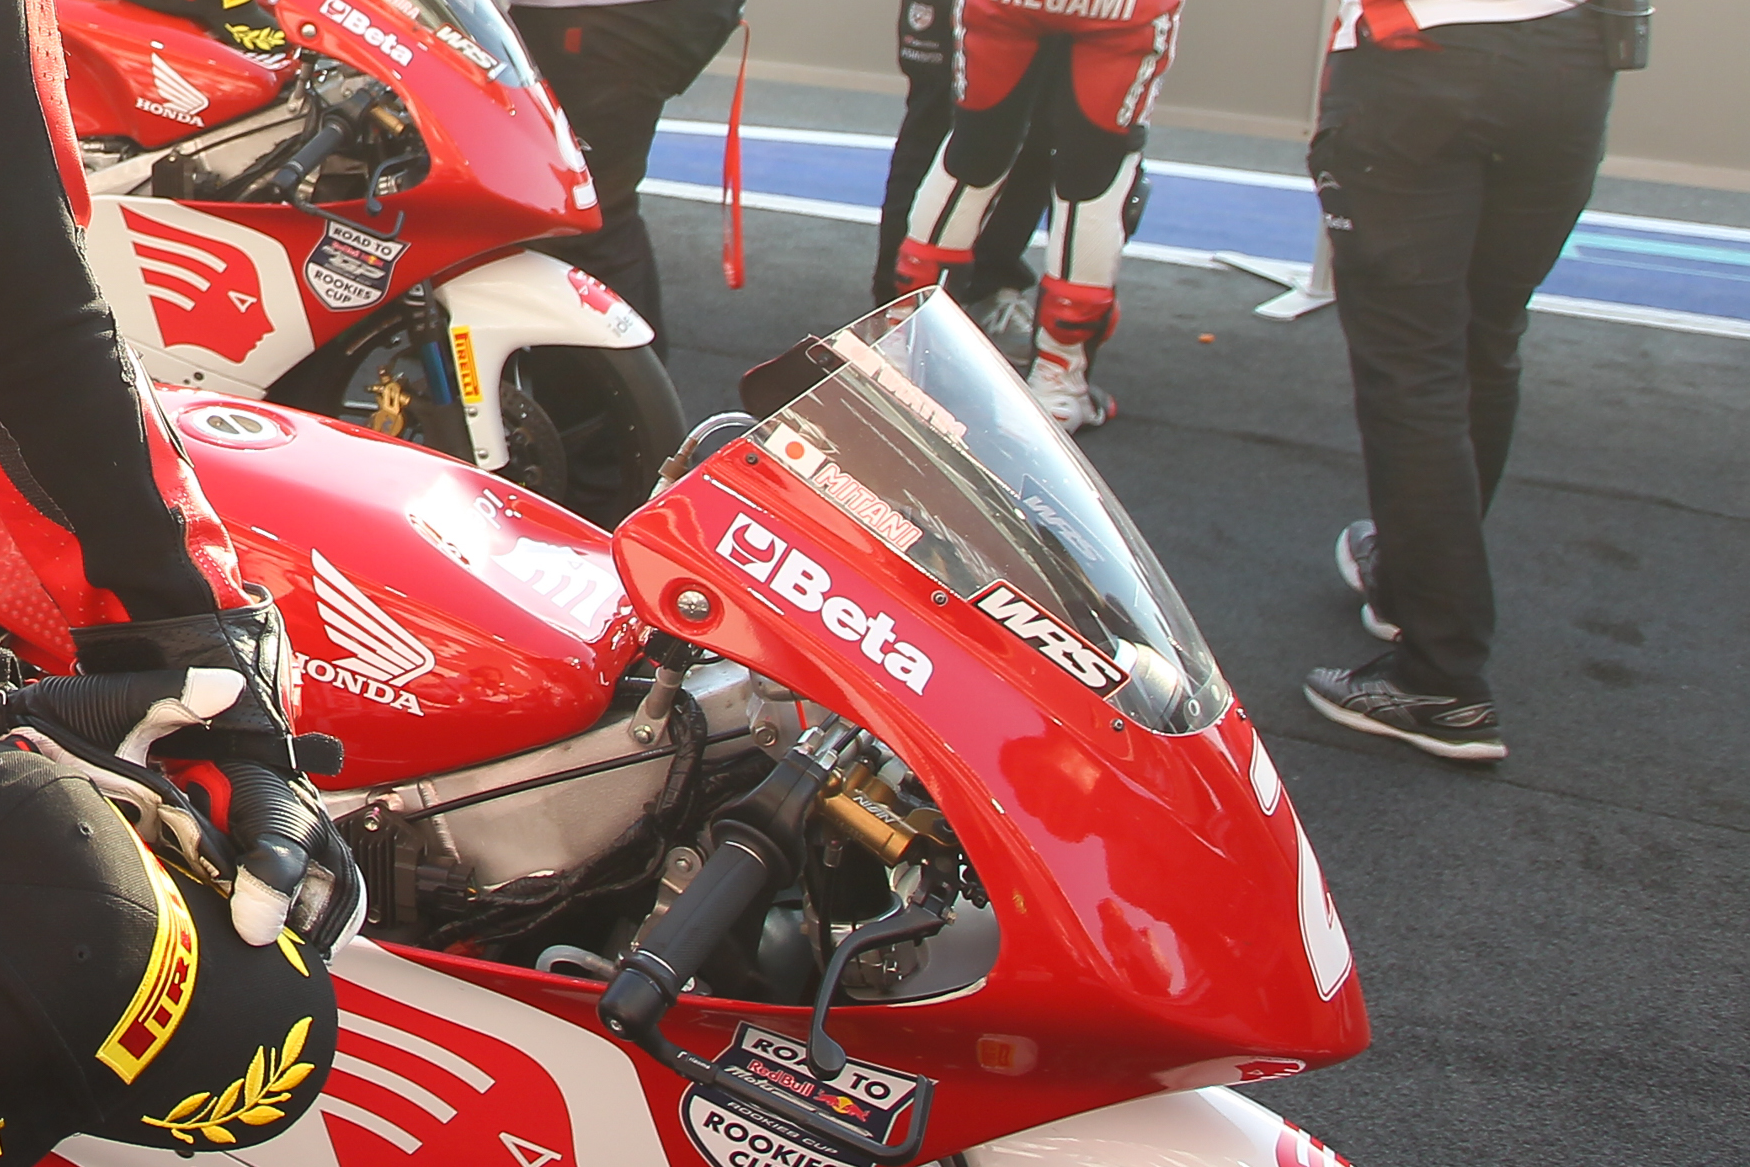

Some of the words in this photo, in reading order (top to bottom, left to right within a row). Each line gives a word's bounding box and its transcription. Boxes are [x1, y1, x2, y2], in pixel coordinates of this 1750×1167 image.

[341, 8, 414, 67] Beta
[135, 96, 205, 128] HONDA
[333, 227, 371, 248] ROAD
[375, 242, 393, 256] TO
[313, 269, 372, 300] ROOKIES
[324, 287, 352, 304] CUP
[453, 332, 480, 398] PIRELLI
[813, 462, 923, 553] MITANI
[768, 547, 934, 697] Beta
[977, 585, 1123, 688] WRS
[850, 1072, 892, 1100] TO
[702, 1110, 836, 1167] ROOKIE
[801, 1136, 839, 1155] CUP
